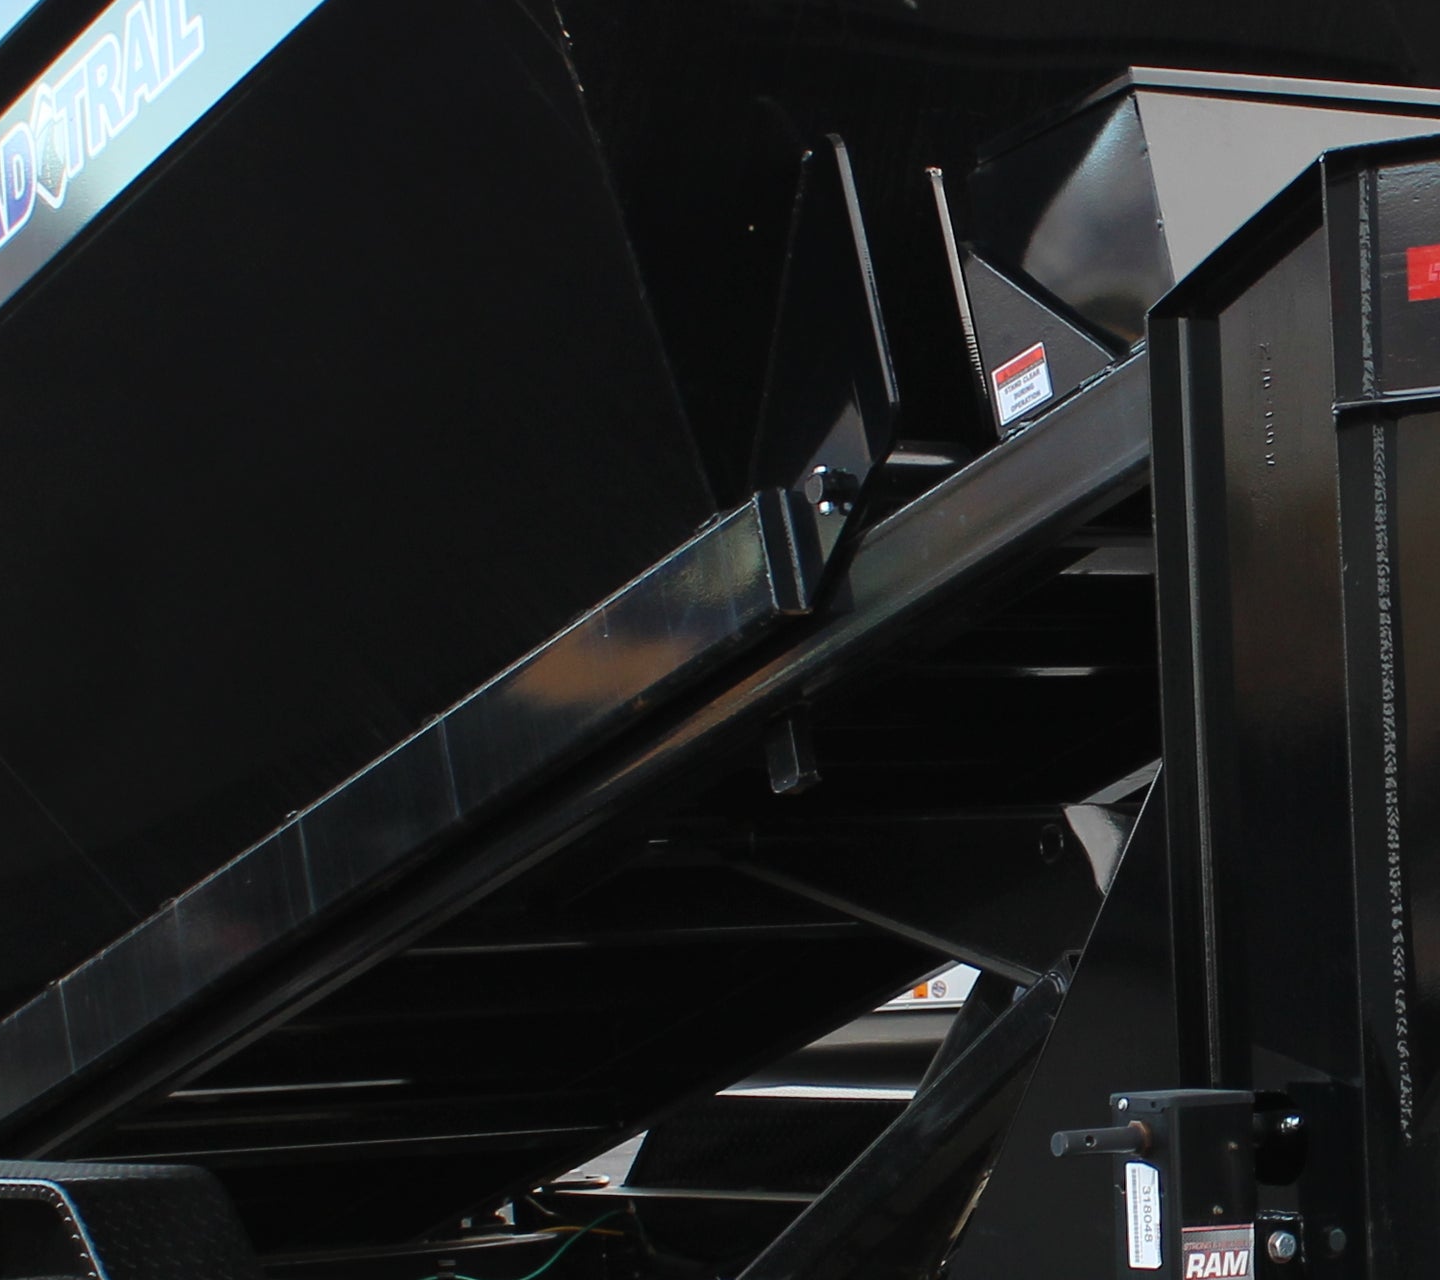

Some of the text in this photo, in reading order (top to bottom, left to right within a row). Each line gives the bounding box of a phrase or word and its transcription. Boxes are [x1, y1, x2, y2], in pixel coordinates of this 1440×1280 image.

[1004, 368, 1041, 395] STAND CLEAR
[1142, 1185, 1153, 1243] 318048
[1185, 1250, 1250, 1280] RAM
